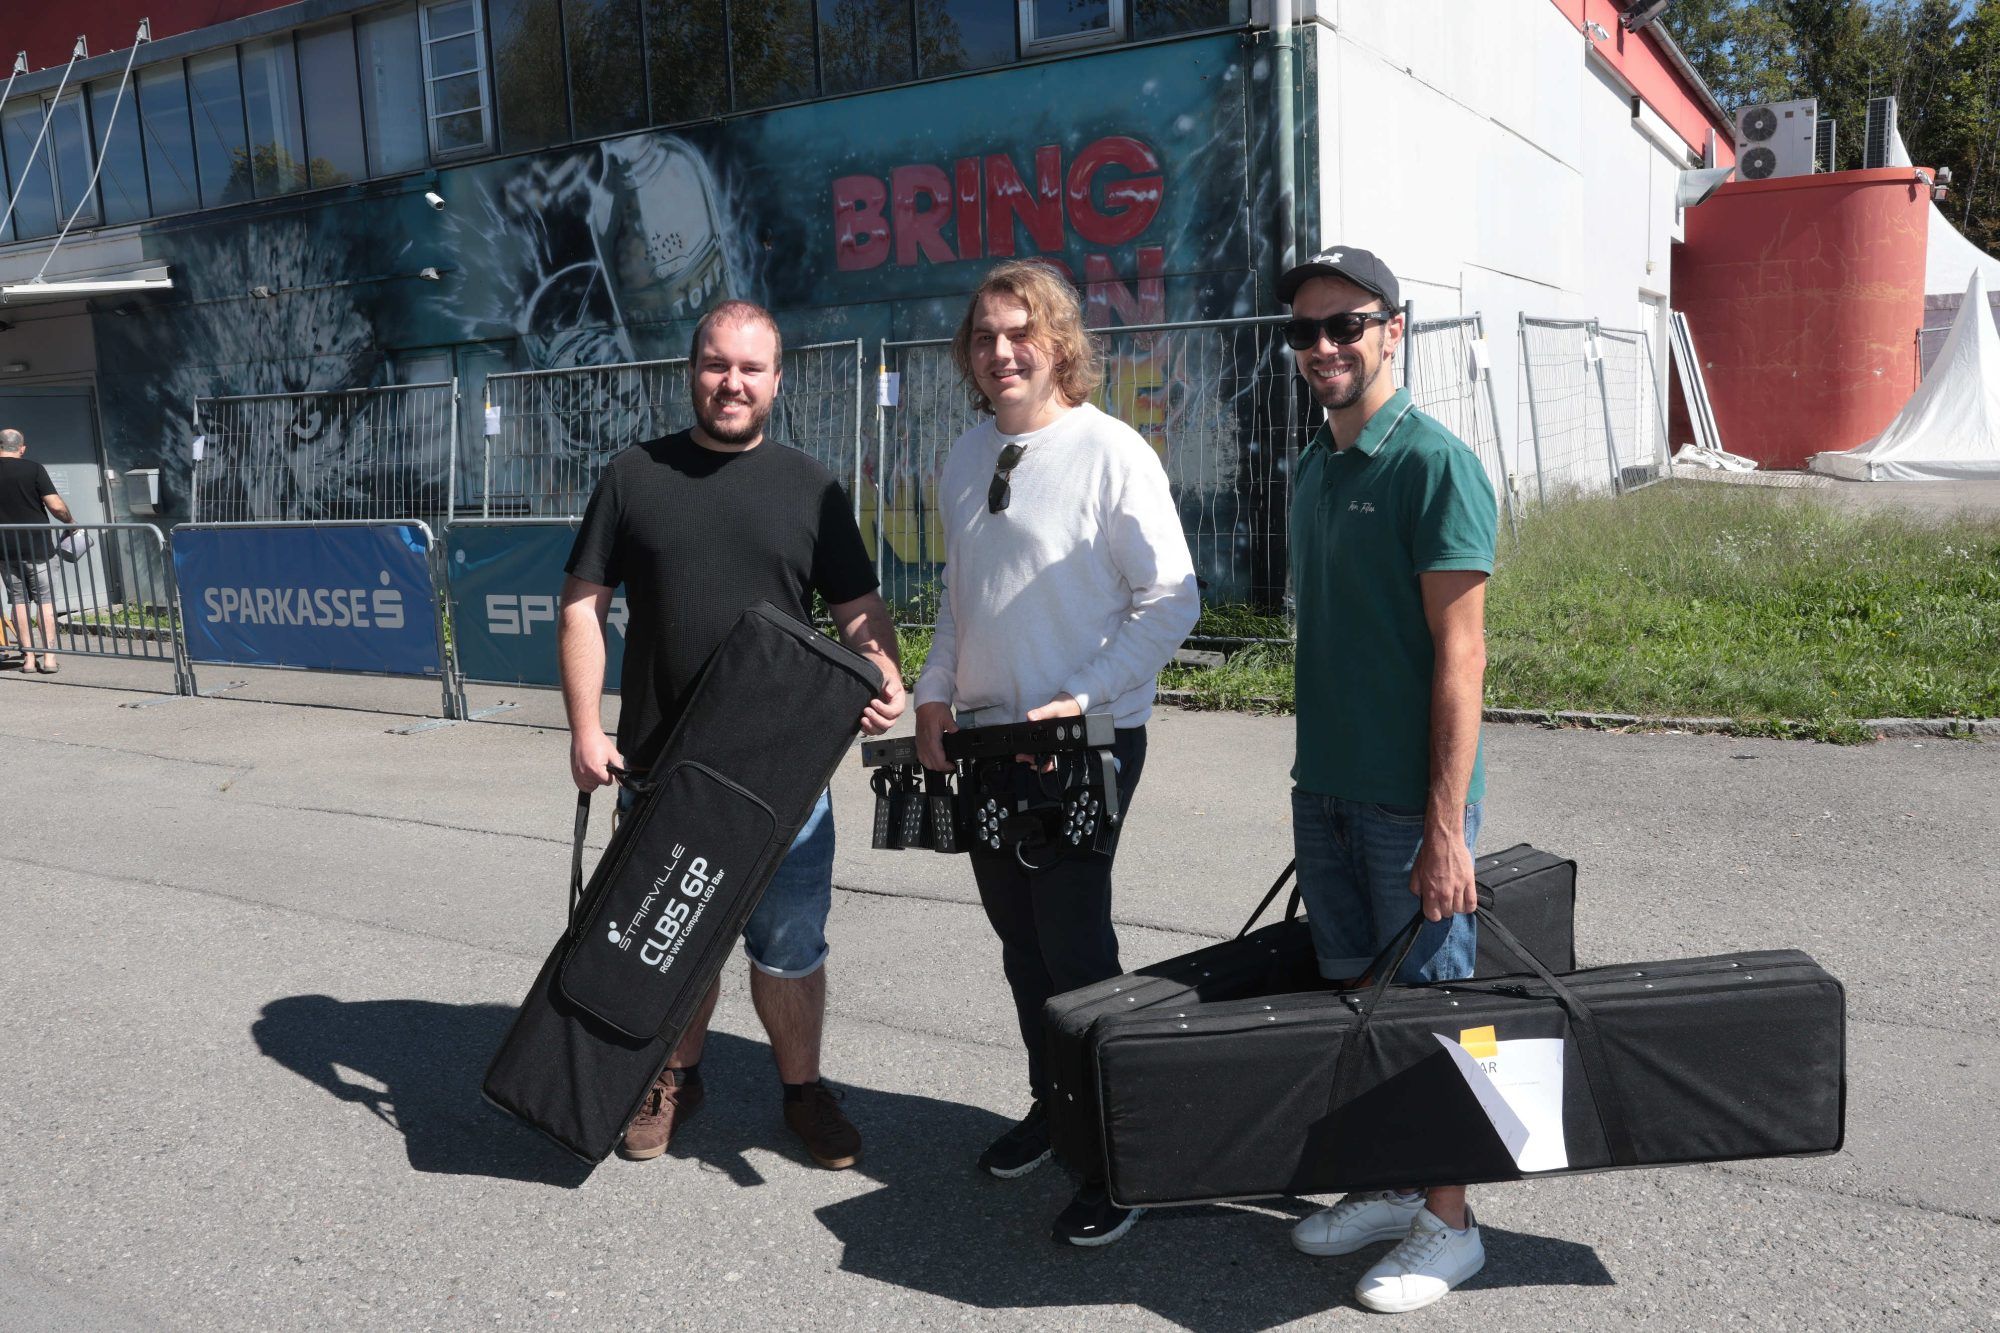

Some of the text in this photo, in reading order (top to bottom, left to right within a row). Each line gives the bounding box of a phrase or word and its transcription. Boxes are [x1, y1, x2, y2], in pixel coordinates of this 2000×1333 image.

[832, 136, 1163, 271] BRING
[204, 587, 370, 628] SPARKASSE
[486, 594, 630, 639] SPR
[618, 843, 686, 951] STAIRVILLE
[640, 856, 709, 966] CLB5 6P
[659, 868, 725, 974] RGB WW Compact LED Bar
